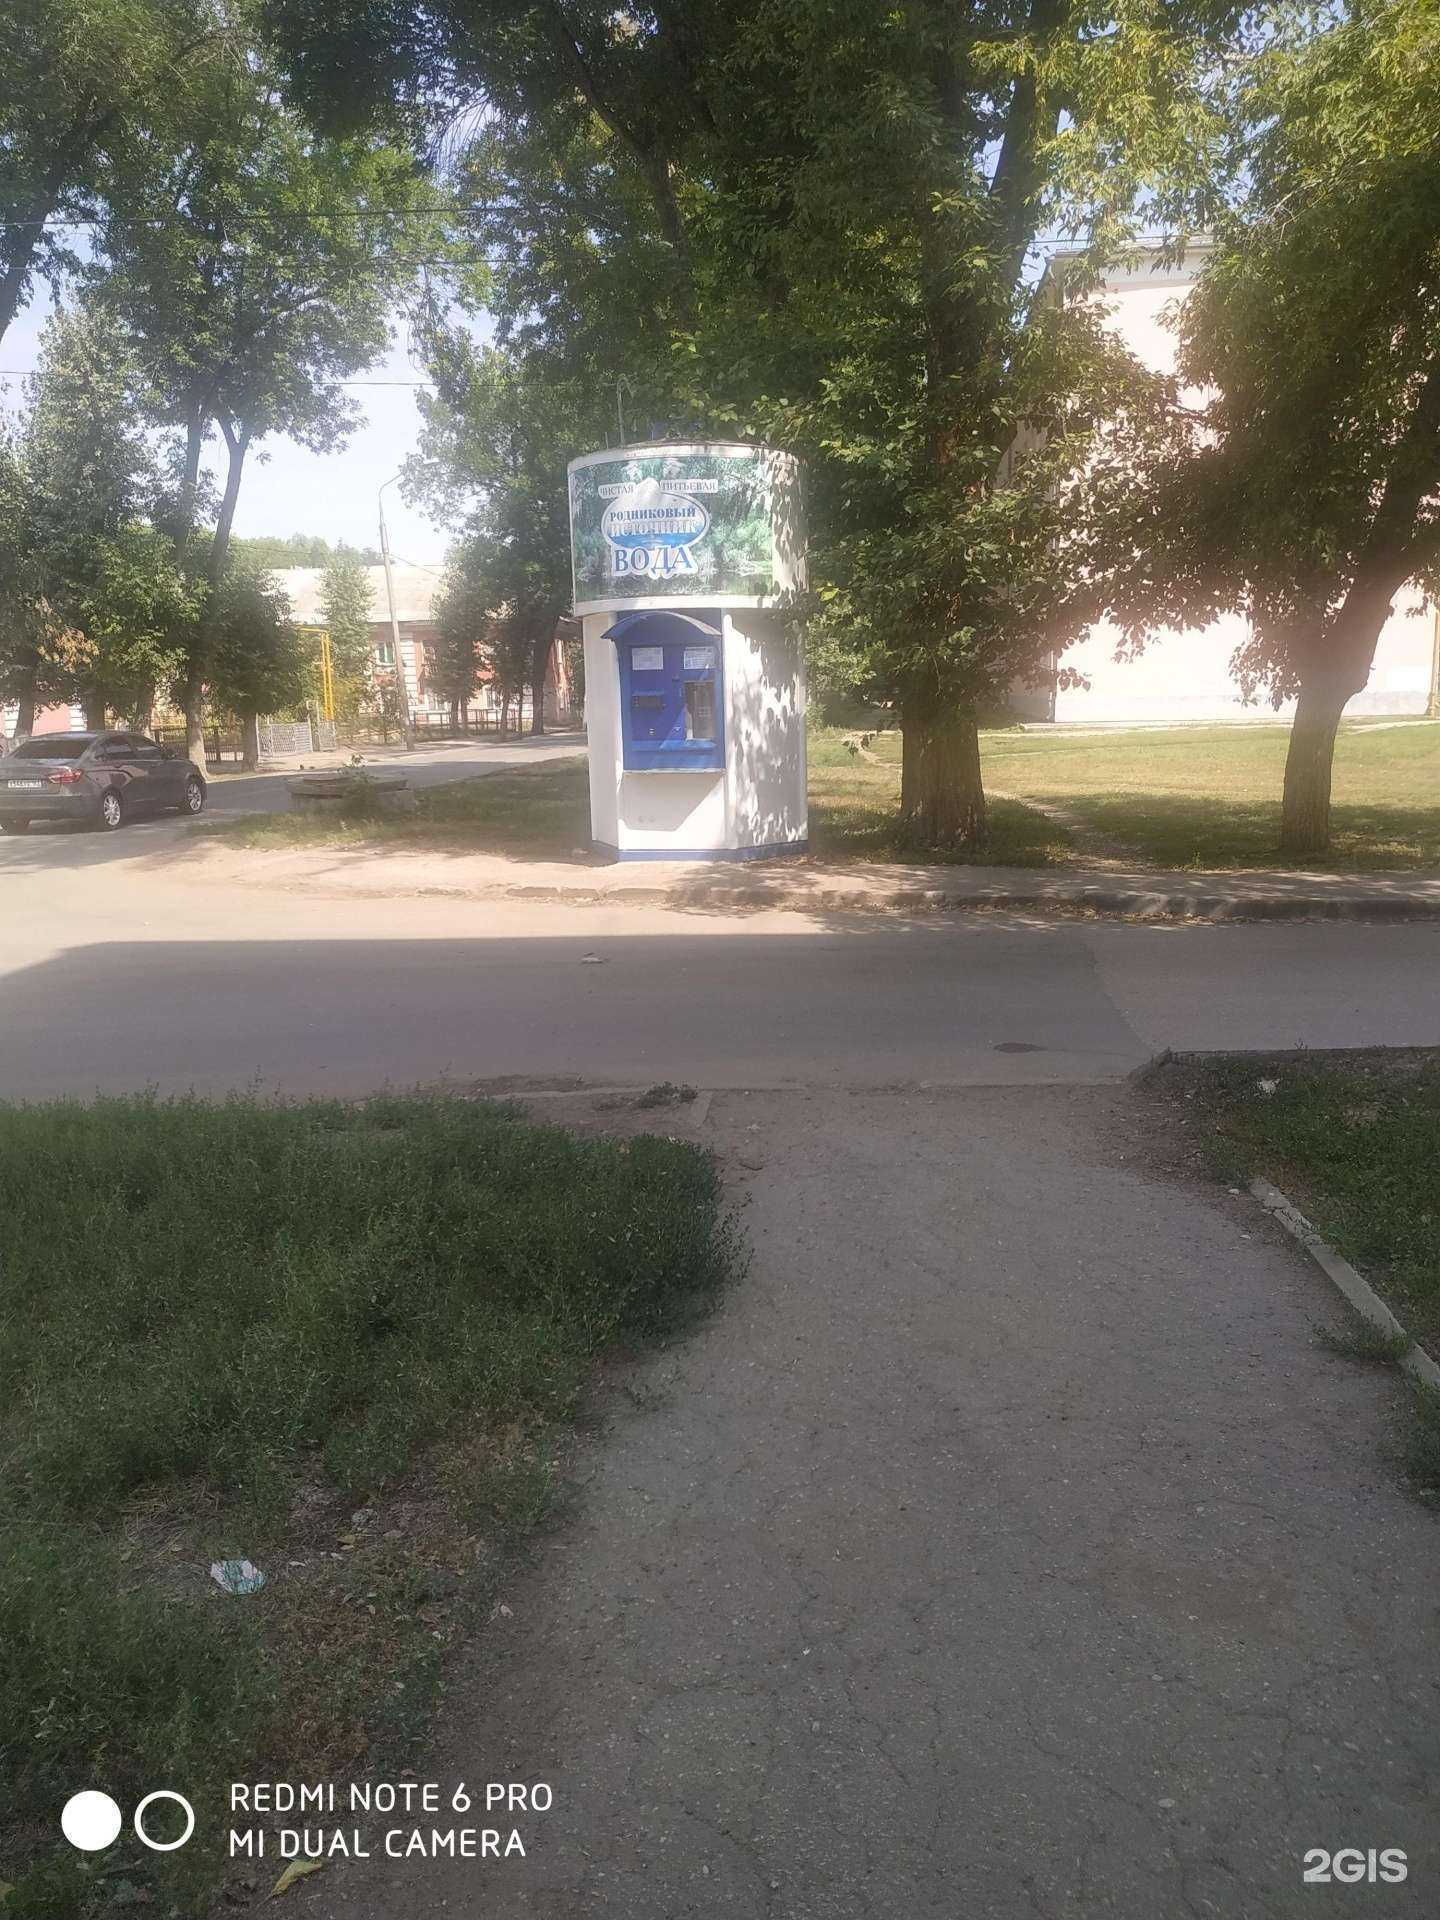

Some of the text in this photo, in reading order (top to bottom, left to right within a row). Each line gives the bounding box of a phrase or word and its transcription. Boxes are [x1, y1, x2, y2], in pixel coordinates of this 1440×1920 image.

[662, 481, 716, 491] ПИТЬЕВАЯ
[610, 507, 696, 522] РОДНИКОВЫЙ
[610, 521, 697, 537] ИСТОЧНИК
[614, 547, 693, 573] ВОДА
